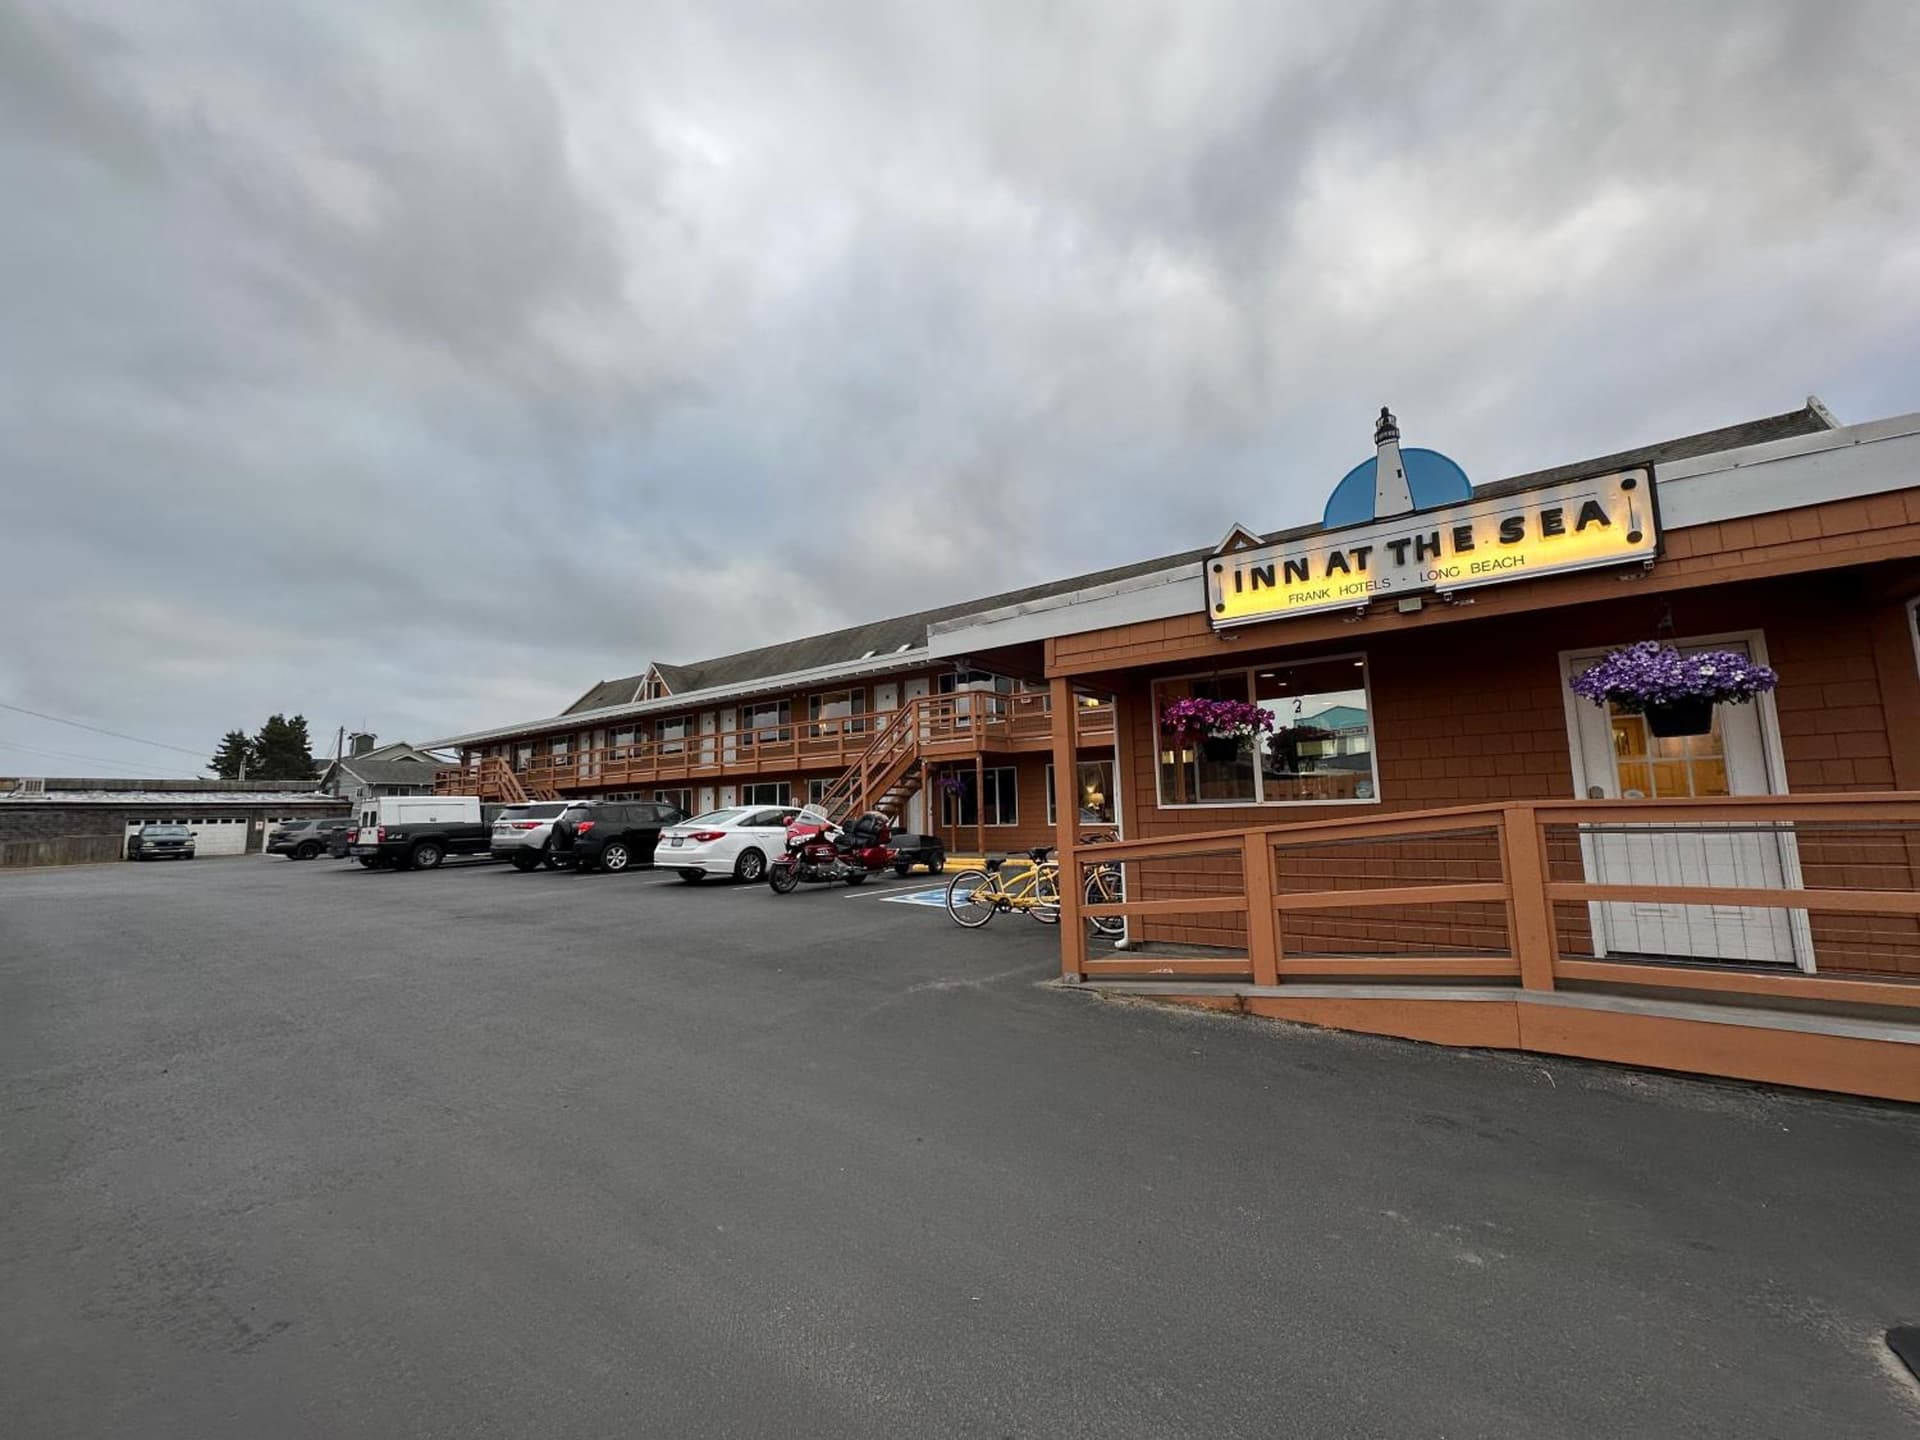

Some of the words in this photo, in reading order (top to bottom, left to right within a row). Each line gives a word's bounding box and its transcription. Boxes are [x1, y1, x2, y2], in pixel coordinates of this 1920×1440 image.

[1234, 558, 1310, 593] INN
[1326, 545, 1373, 577] AT
[1387, 525, 1475, 565] THE
[1499, 500, 1612, 544] SEA
[1288, 588, 1331, 605] FRANK
[1339, 578, 1391, 597] HOTELS
[1419, 566, 1460, 583] LONG
[1470, 554, 1525, 575] BEACH
